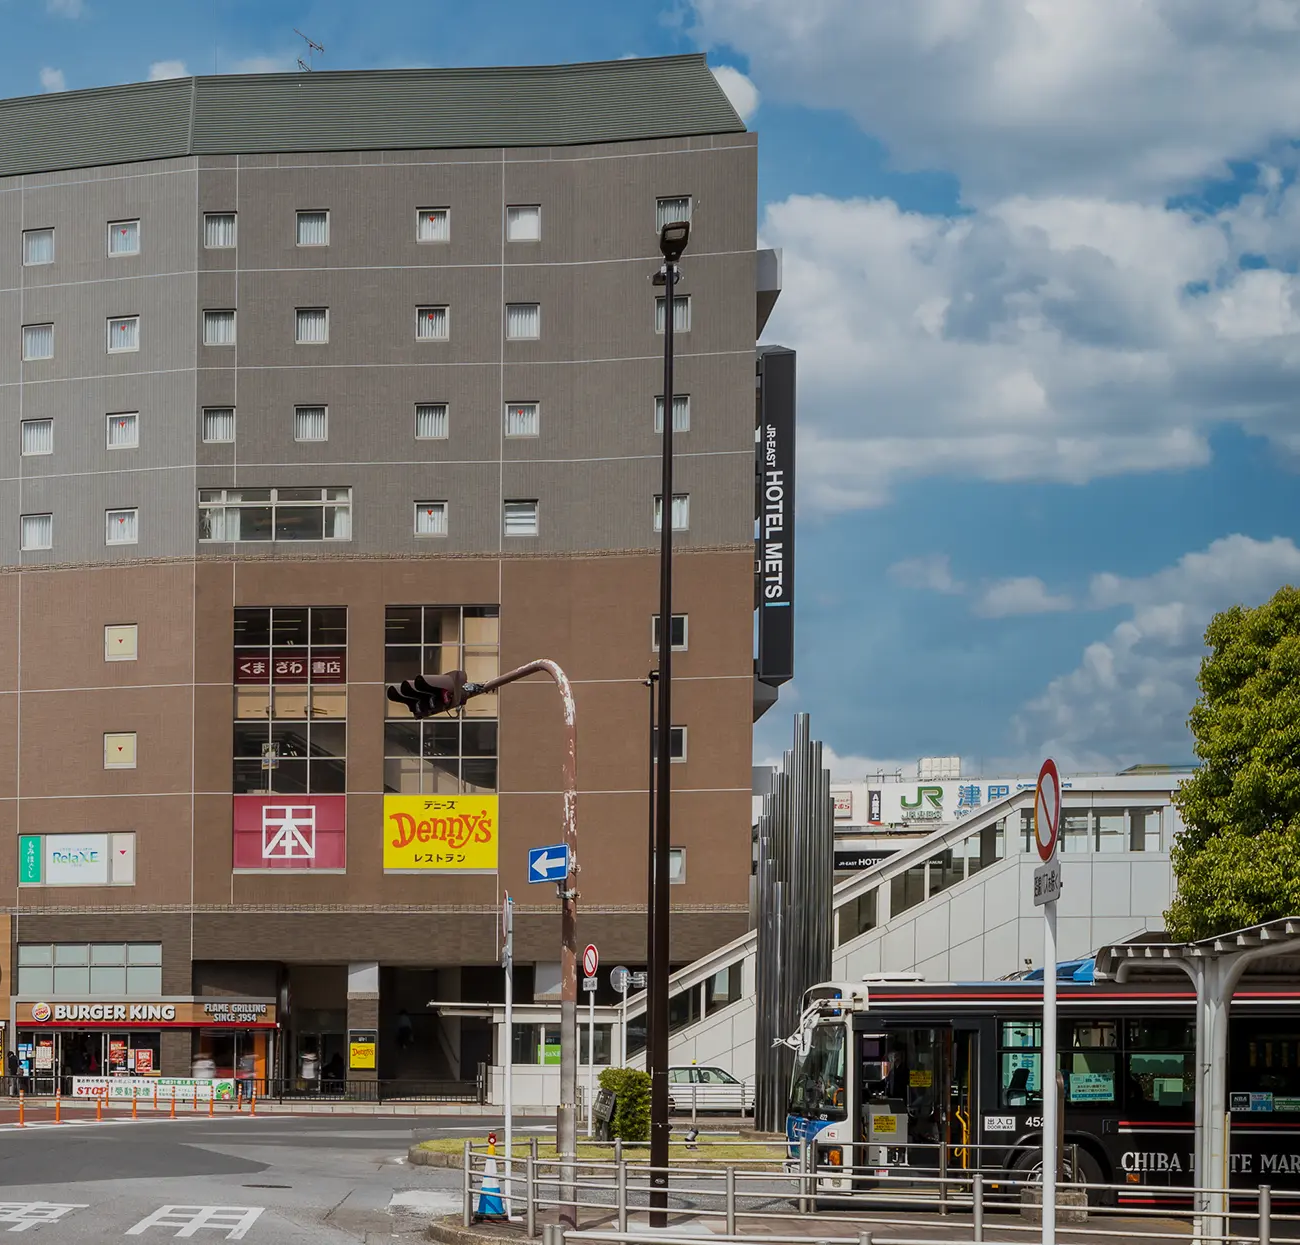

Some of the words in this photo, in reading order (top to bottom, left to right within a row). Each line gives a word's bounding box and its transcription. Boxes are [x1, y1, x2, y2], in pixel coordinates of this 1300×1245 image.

[766, 470, 783, 539] HOTEL
[765, 543, 783, 599] METS
[424, 801, 456, 809] デニーズ
[901, 786, 943, 809] JR
[262, 805, 316, 858] 本
[389, 810, 492, 849] Denny's
[415, 854, 466, 862] レストラン
[55, 1005, 126, 1019] BURGER
[130, 1005, 175, 1019] KING
[204, 1004, 228, 1012] FLAME
[231, 1004, 267, 1012] GRILLING
[214, 1014, 235, 1022] SINCE
[238, 1014, 256, 1022] 1954
[1121, 1152, 1183, 1172] CHIBA
